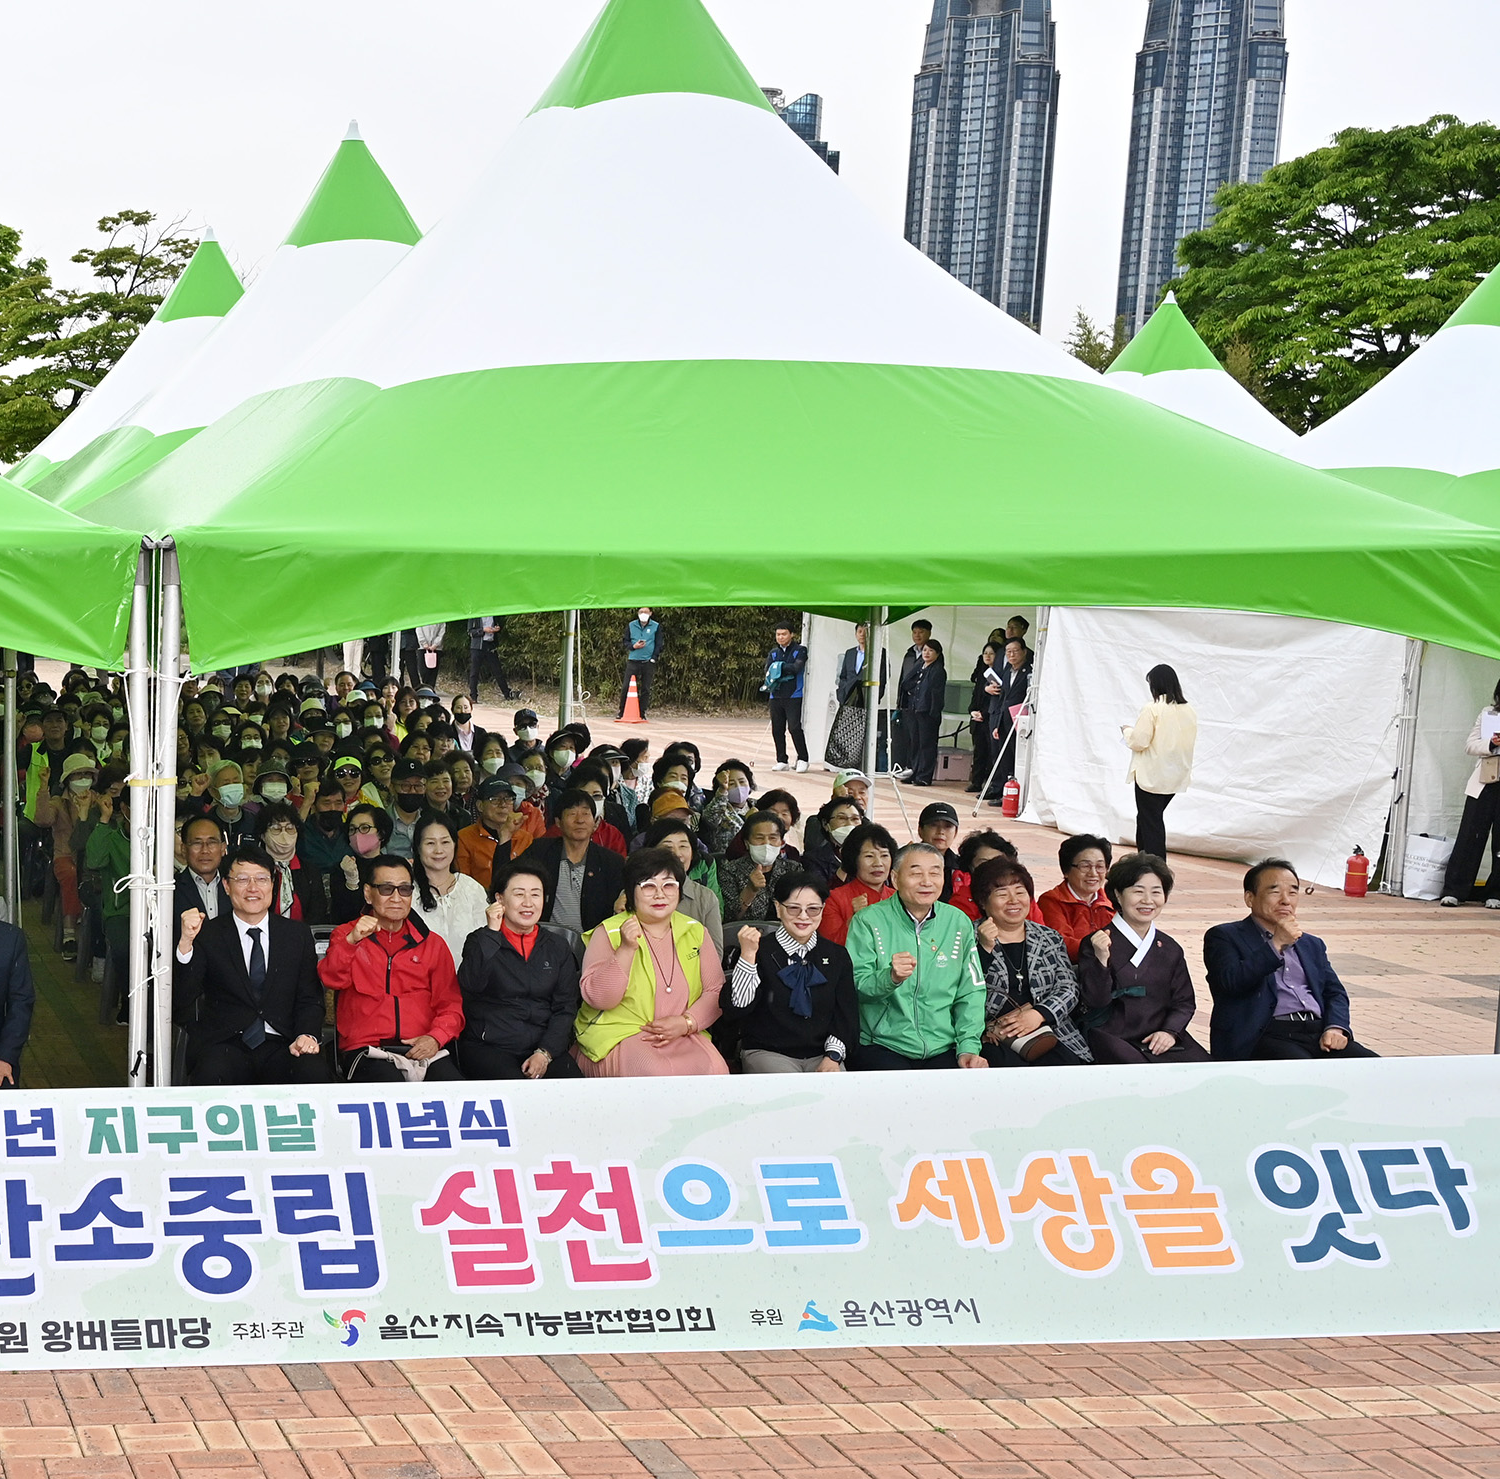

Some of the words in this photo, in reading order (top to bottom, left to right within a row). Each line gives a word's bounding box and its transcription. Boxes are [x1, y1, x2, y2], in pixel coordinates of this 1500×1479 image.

[86, 1103, 317, 1155] 지구의날
[337, 1098, 511, 1149] 기념식
[420, 1160, 861, 1287] 실천으로
[896, 1152, 1237, 1271] 세상을
[1255, 1146, 1470, 1263] 잇다
[749, 1308, 785, 1327] 후원
[839, 1298, 981, 1328] 울산광역시
[41, 1317, 212, 1353] 왕버들마당
